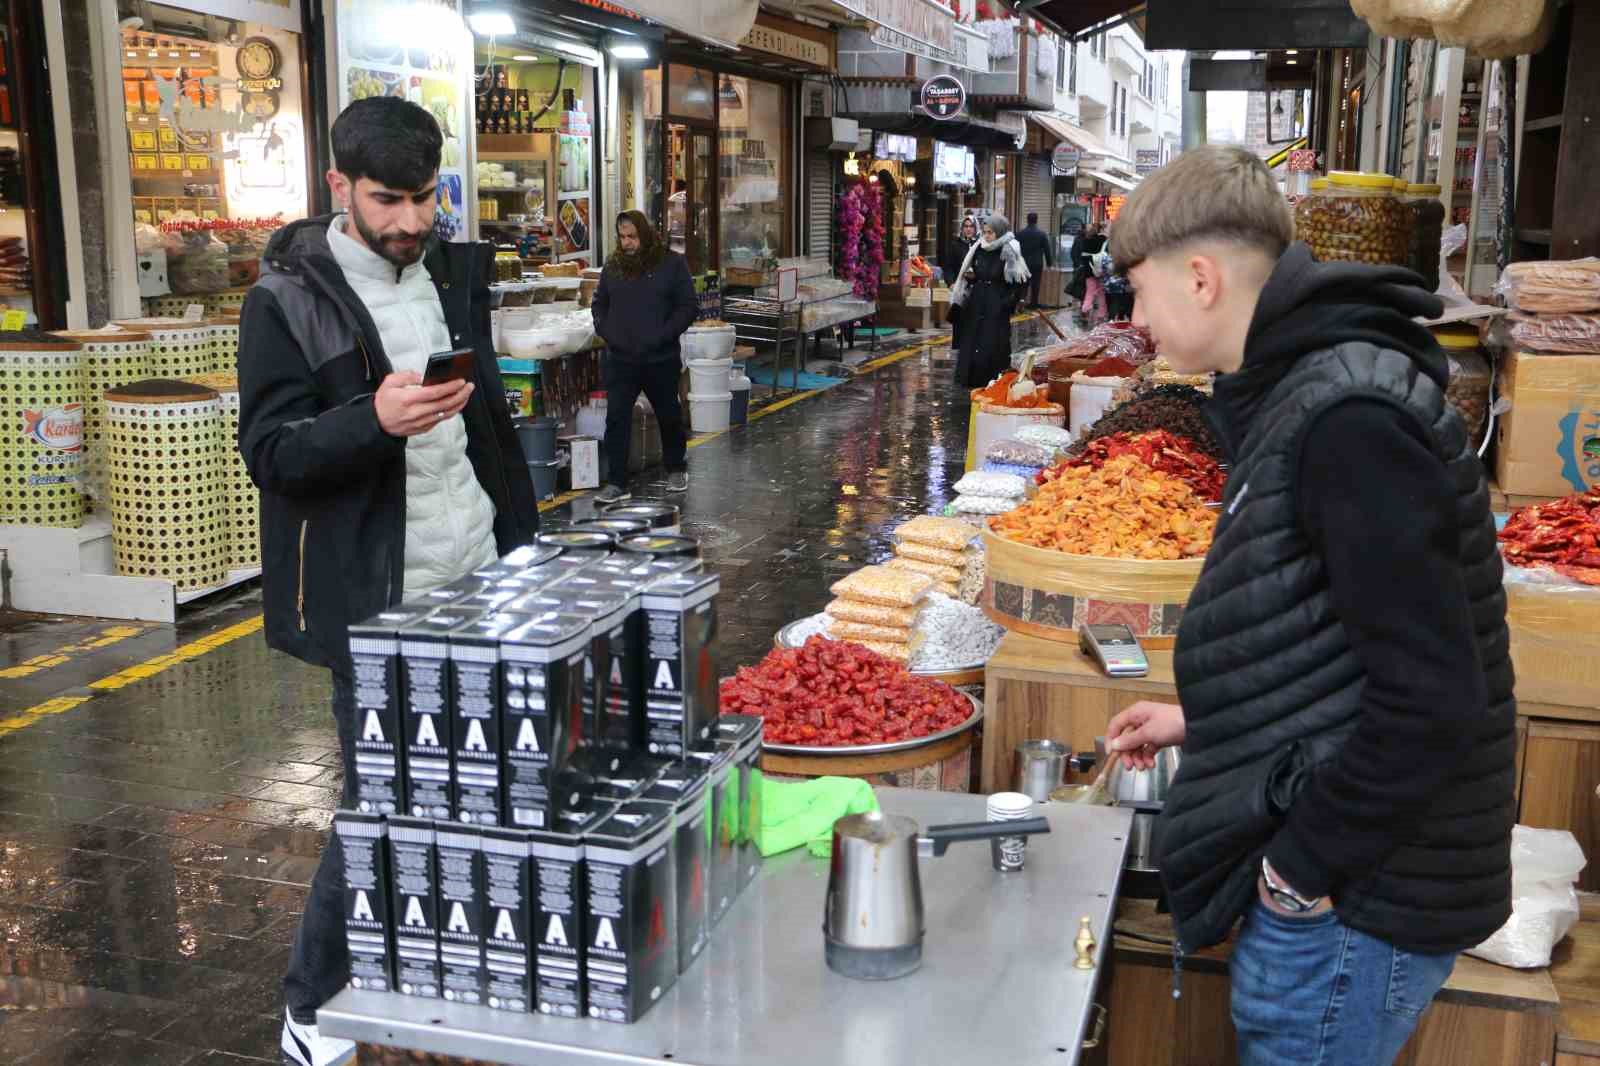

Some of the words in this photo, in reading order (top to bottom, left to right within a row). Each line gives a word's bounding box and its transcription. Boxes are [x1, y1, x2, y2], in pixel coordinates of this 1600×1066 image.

[654, 660, 675, 690] A
[363, 709, 385, 742] A
[416, 713, 440, 747] A
[465, 718, 488, 752] A
[516, 718, 540, 751] A
[353, 889, 375, 921] A
[405, 895, 427, 928] A
[447, 901, 470, 934] A
[494, 908, 517, 942] A
[545, 913, 569, 947] A
[594, 917, 618, 950] A
